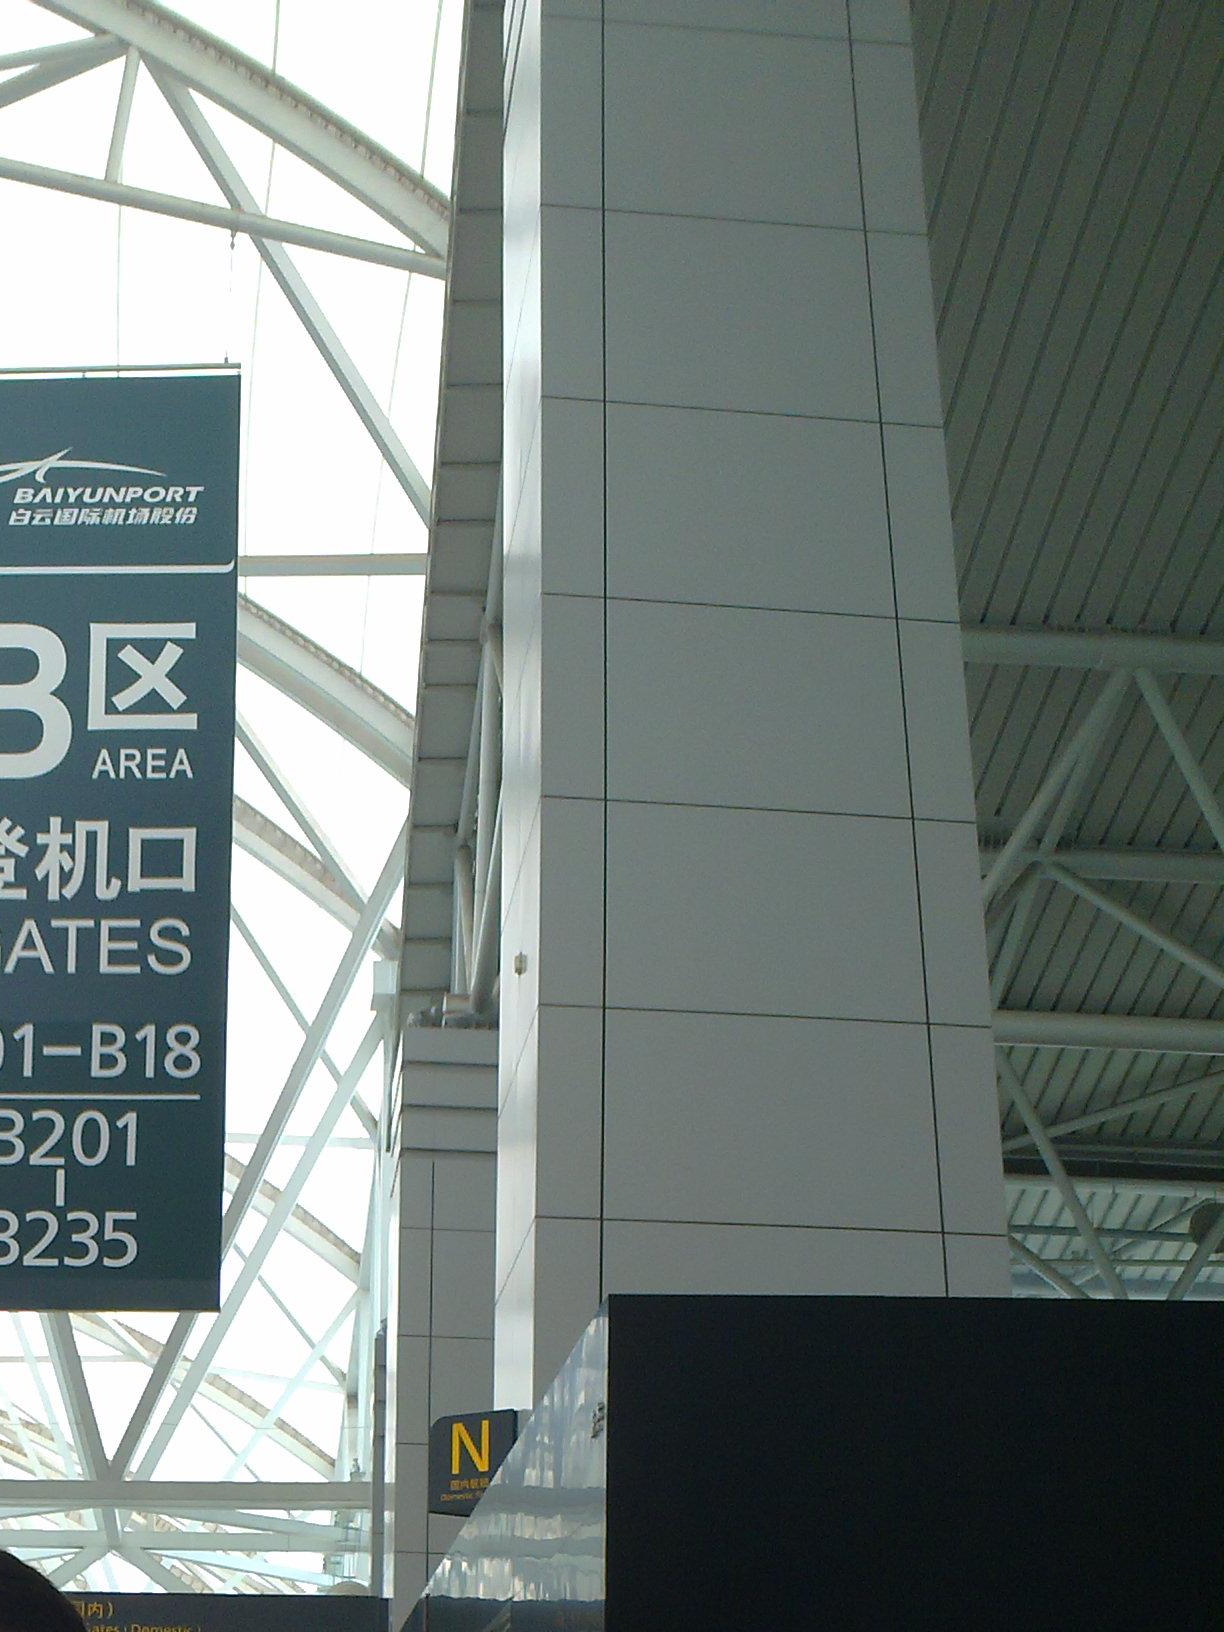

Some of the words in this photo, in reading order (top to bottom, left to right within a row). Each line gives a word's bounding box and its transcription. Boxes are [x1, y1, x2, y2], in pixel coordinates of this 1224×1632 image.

[12, 486, 205, 504] BAIYUNPORT
[8, 507, 198, 526] 白云国际机场股份
[91, 748, 194, 780] AREA
[451, 1419, 490, 1475] N
